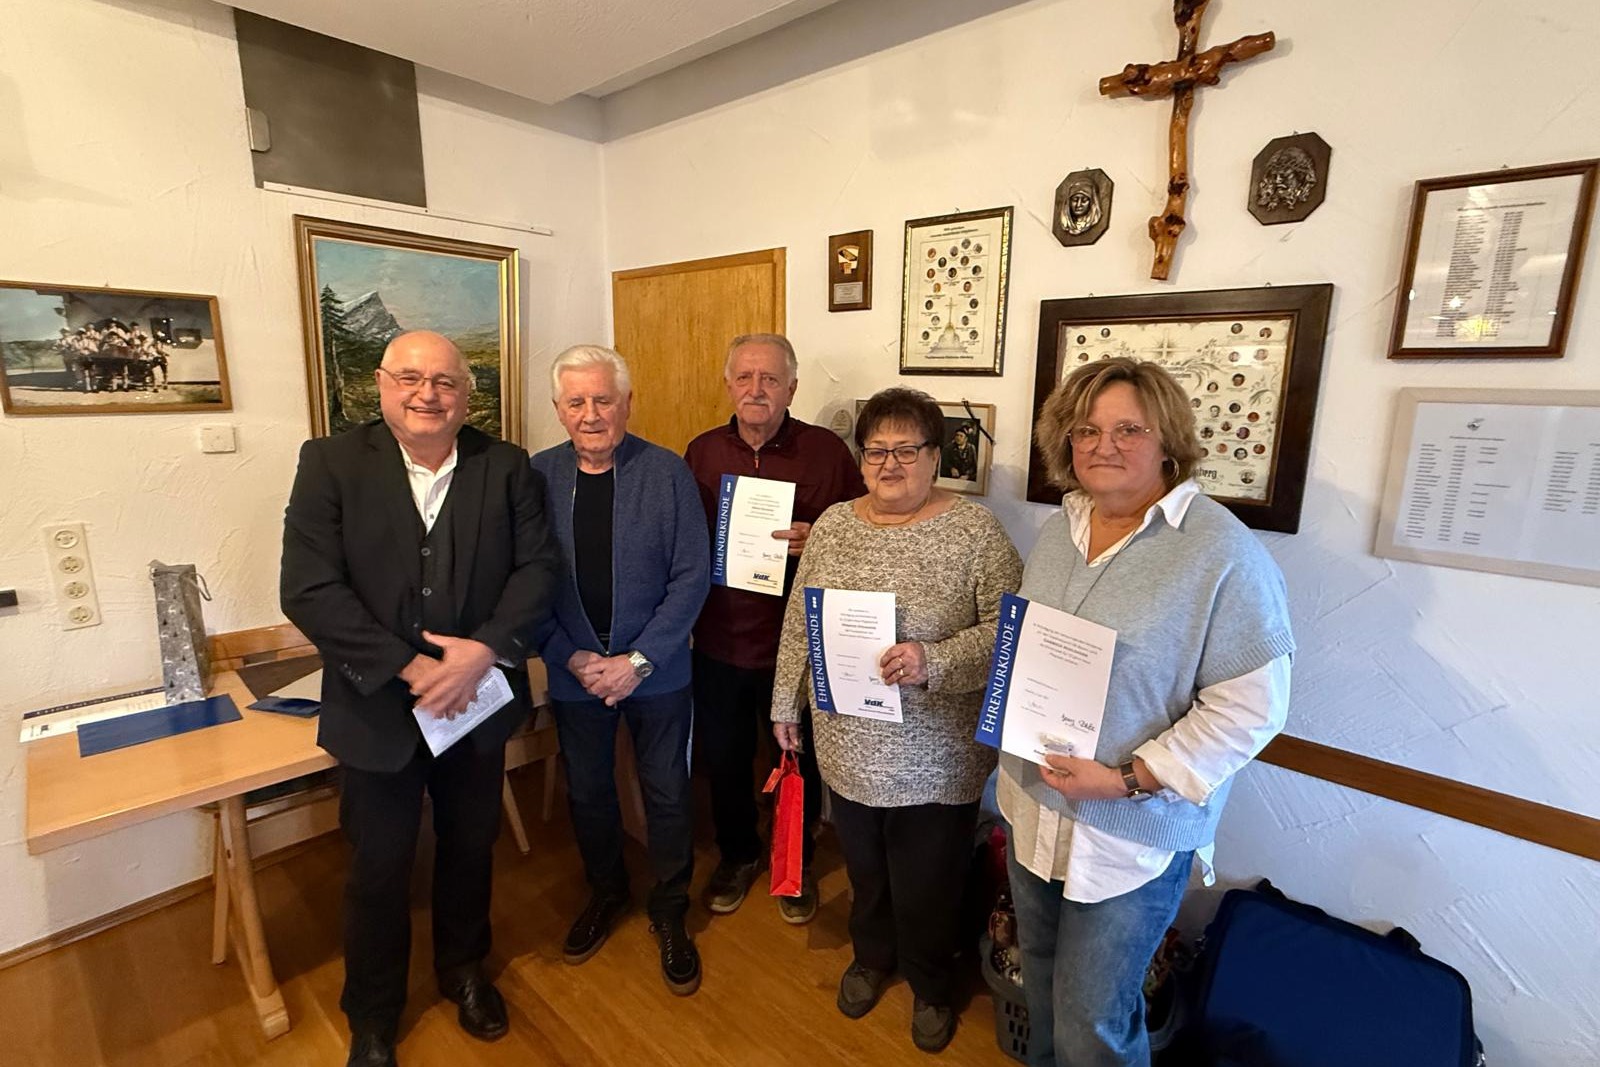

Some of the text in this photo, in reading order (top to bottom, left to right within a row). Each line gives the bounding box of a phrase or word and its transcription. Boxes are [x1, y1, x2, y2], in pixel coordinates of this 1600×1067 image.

[713, 497, 730, 576] EHRENURKUNDE
[809, 613, 828, 703] EHRENURKUNDE
[981, 622, 1015, 734] EHRENURKUNDE
[864, 699, 885, 708] VdK
